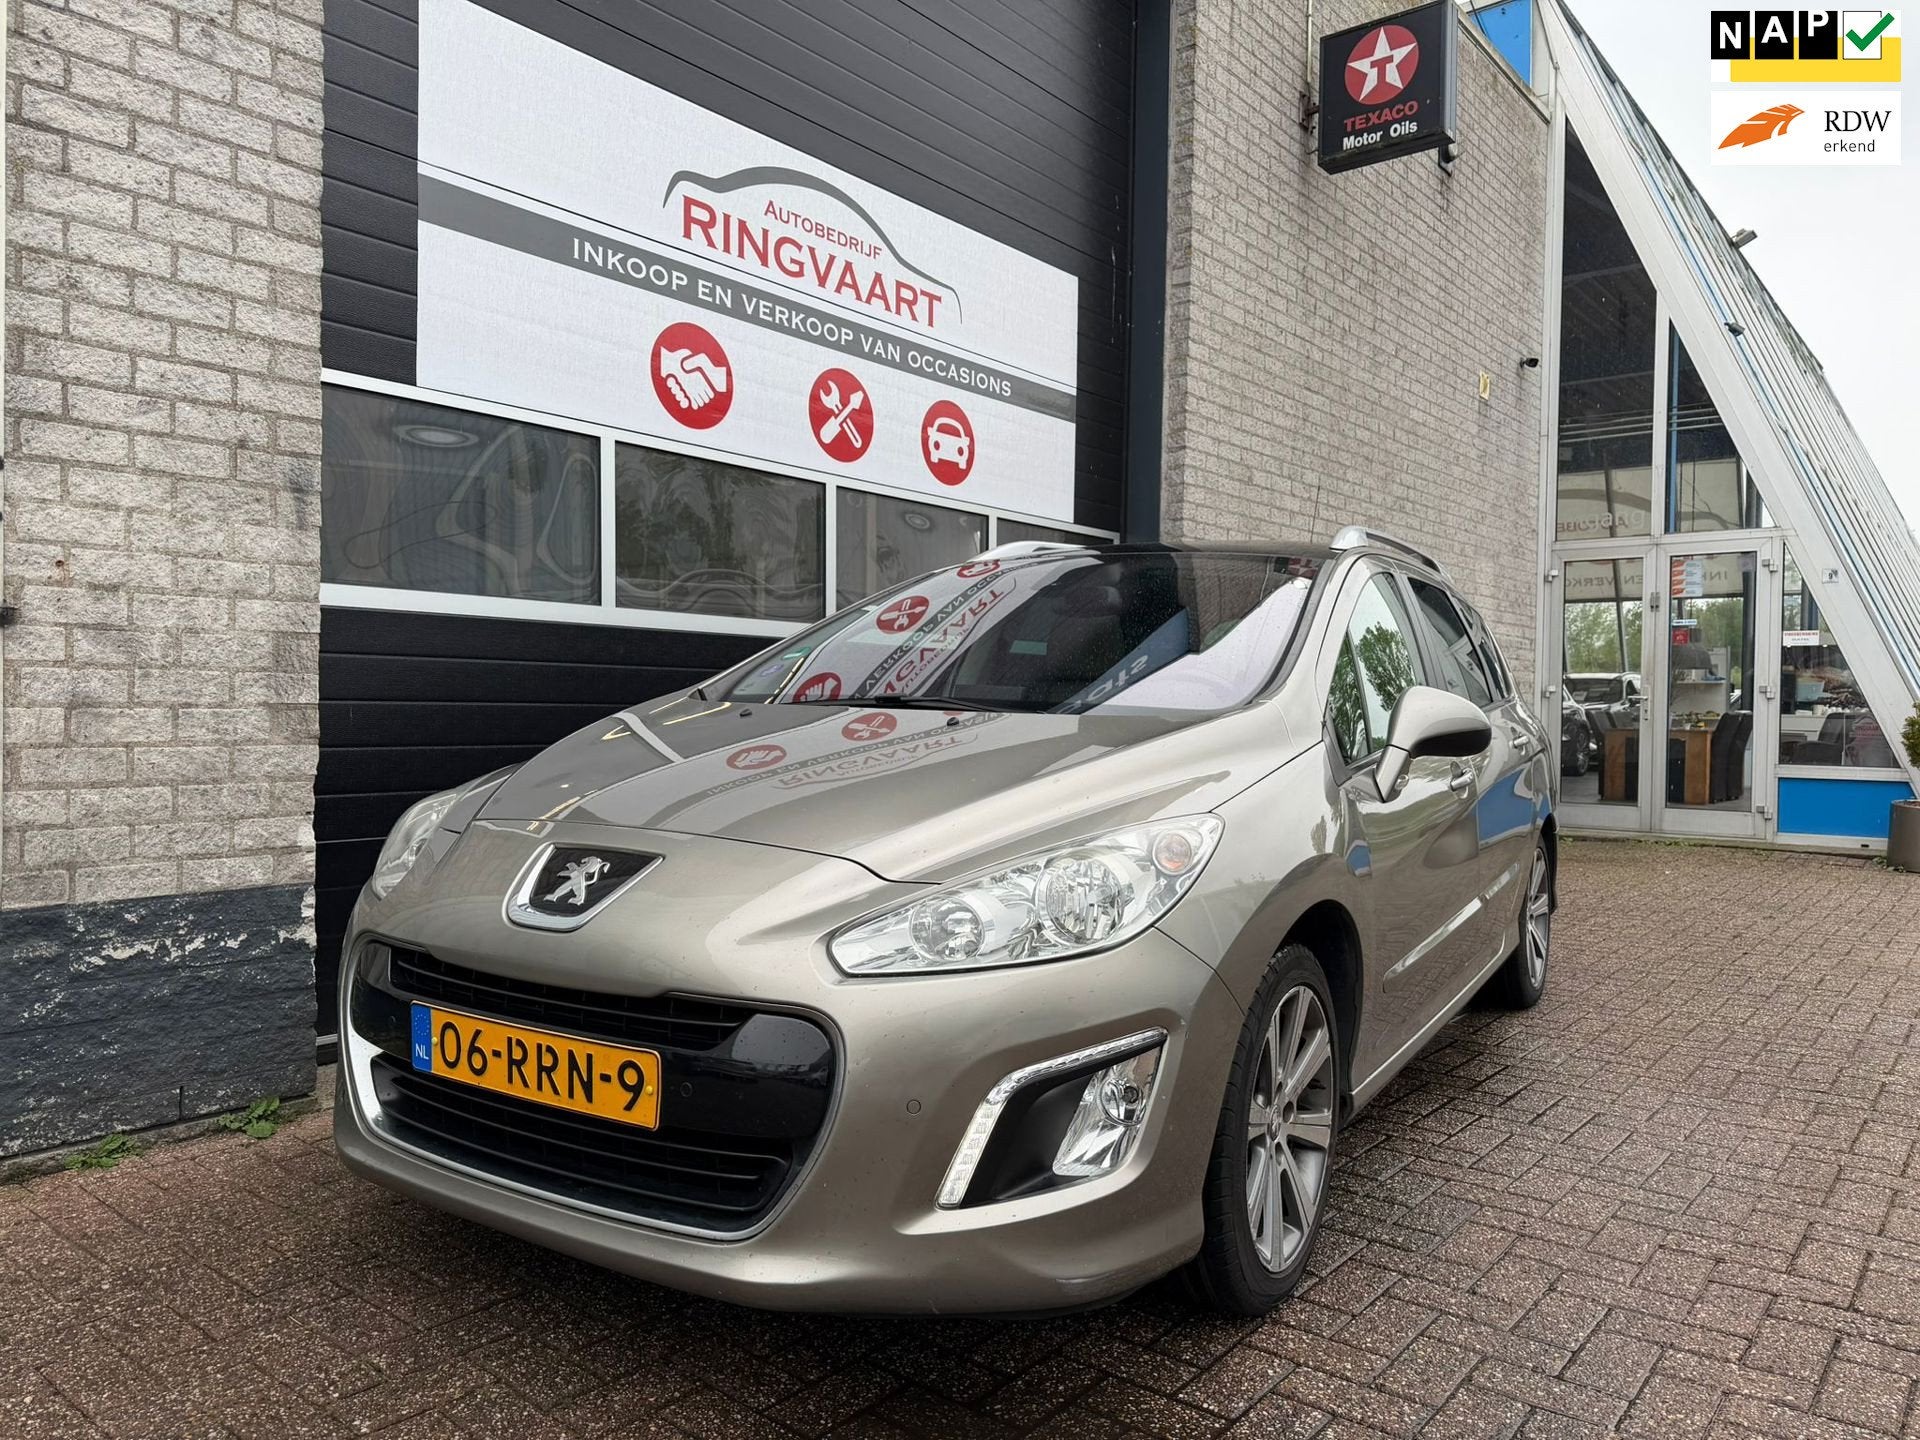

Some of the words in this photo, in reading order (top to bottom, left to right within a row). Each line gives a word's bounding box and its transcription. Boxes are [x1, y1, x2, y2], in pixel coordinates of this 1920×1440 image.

[1342, 129, 1384, 150] Motor
[1389, 120, 1418, 138] Oils
[1343, 100, 1419, 132] TEXACO
[682, 194, 943, 328] RINGVAART
[573, 237, 689, 292] INKOOP
[697, 278, 733, 309] EN
[741, 292, 854, 346] VERKOOP
[860, 333, 901, 363] VAN
[908, 350, 1013, 397] OCCASIONS
[415, 1044, 430, 1061] NL
[439, 1020, 646, 1112] 06-RRN-9
